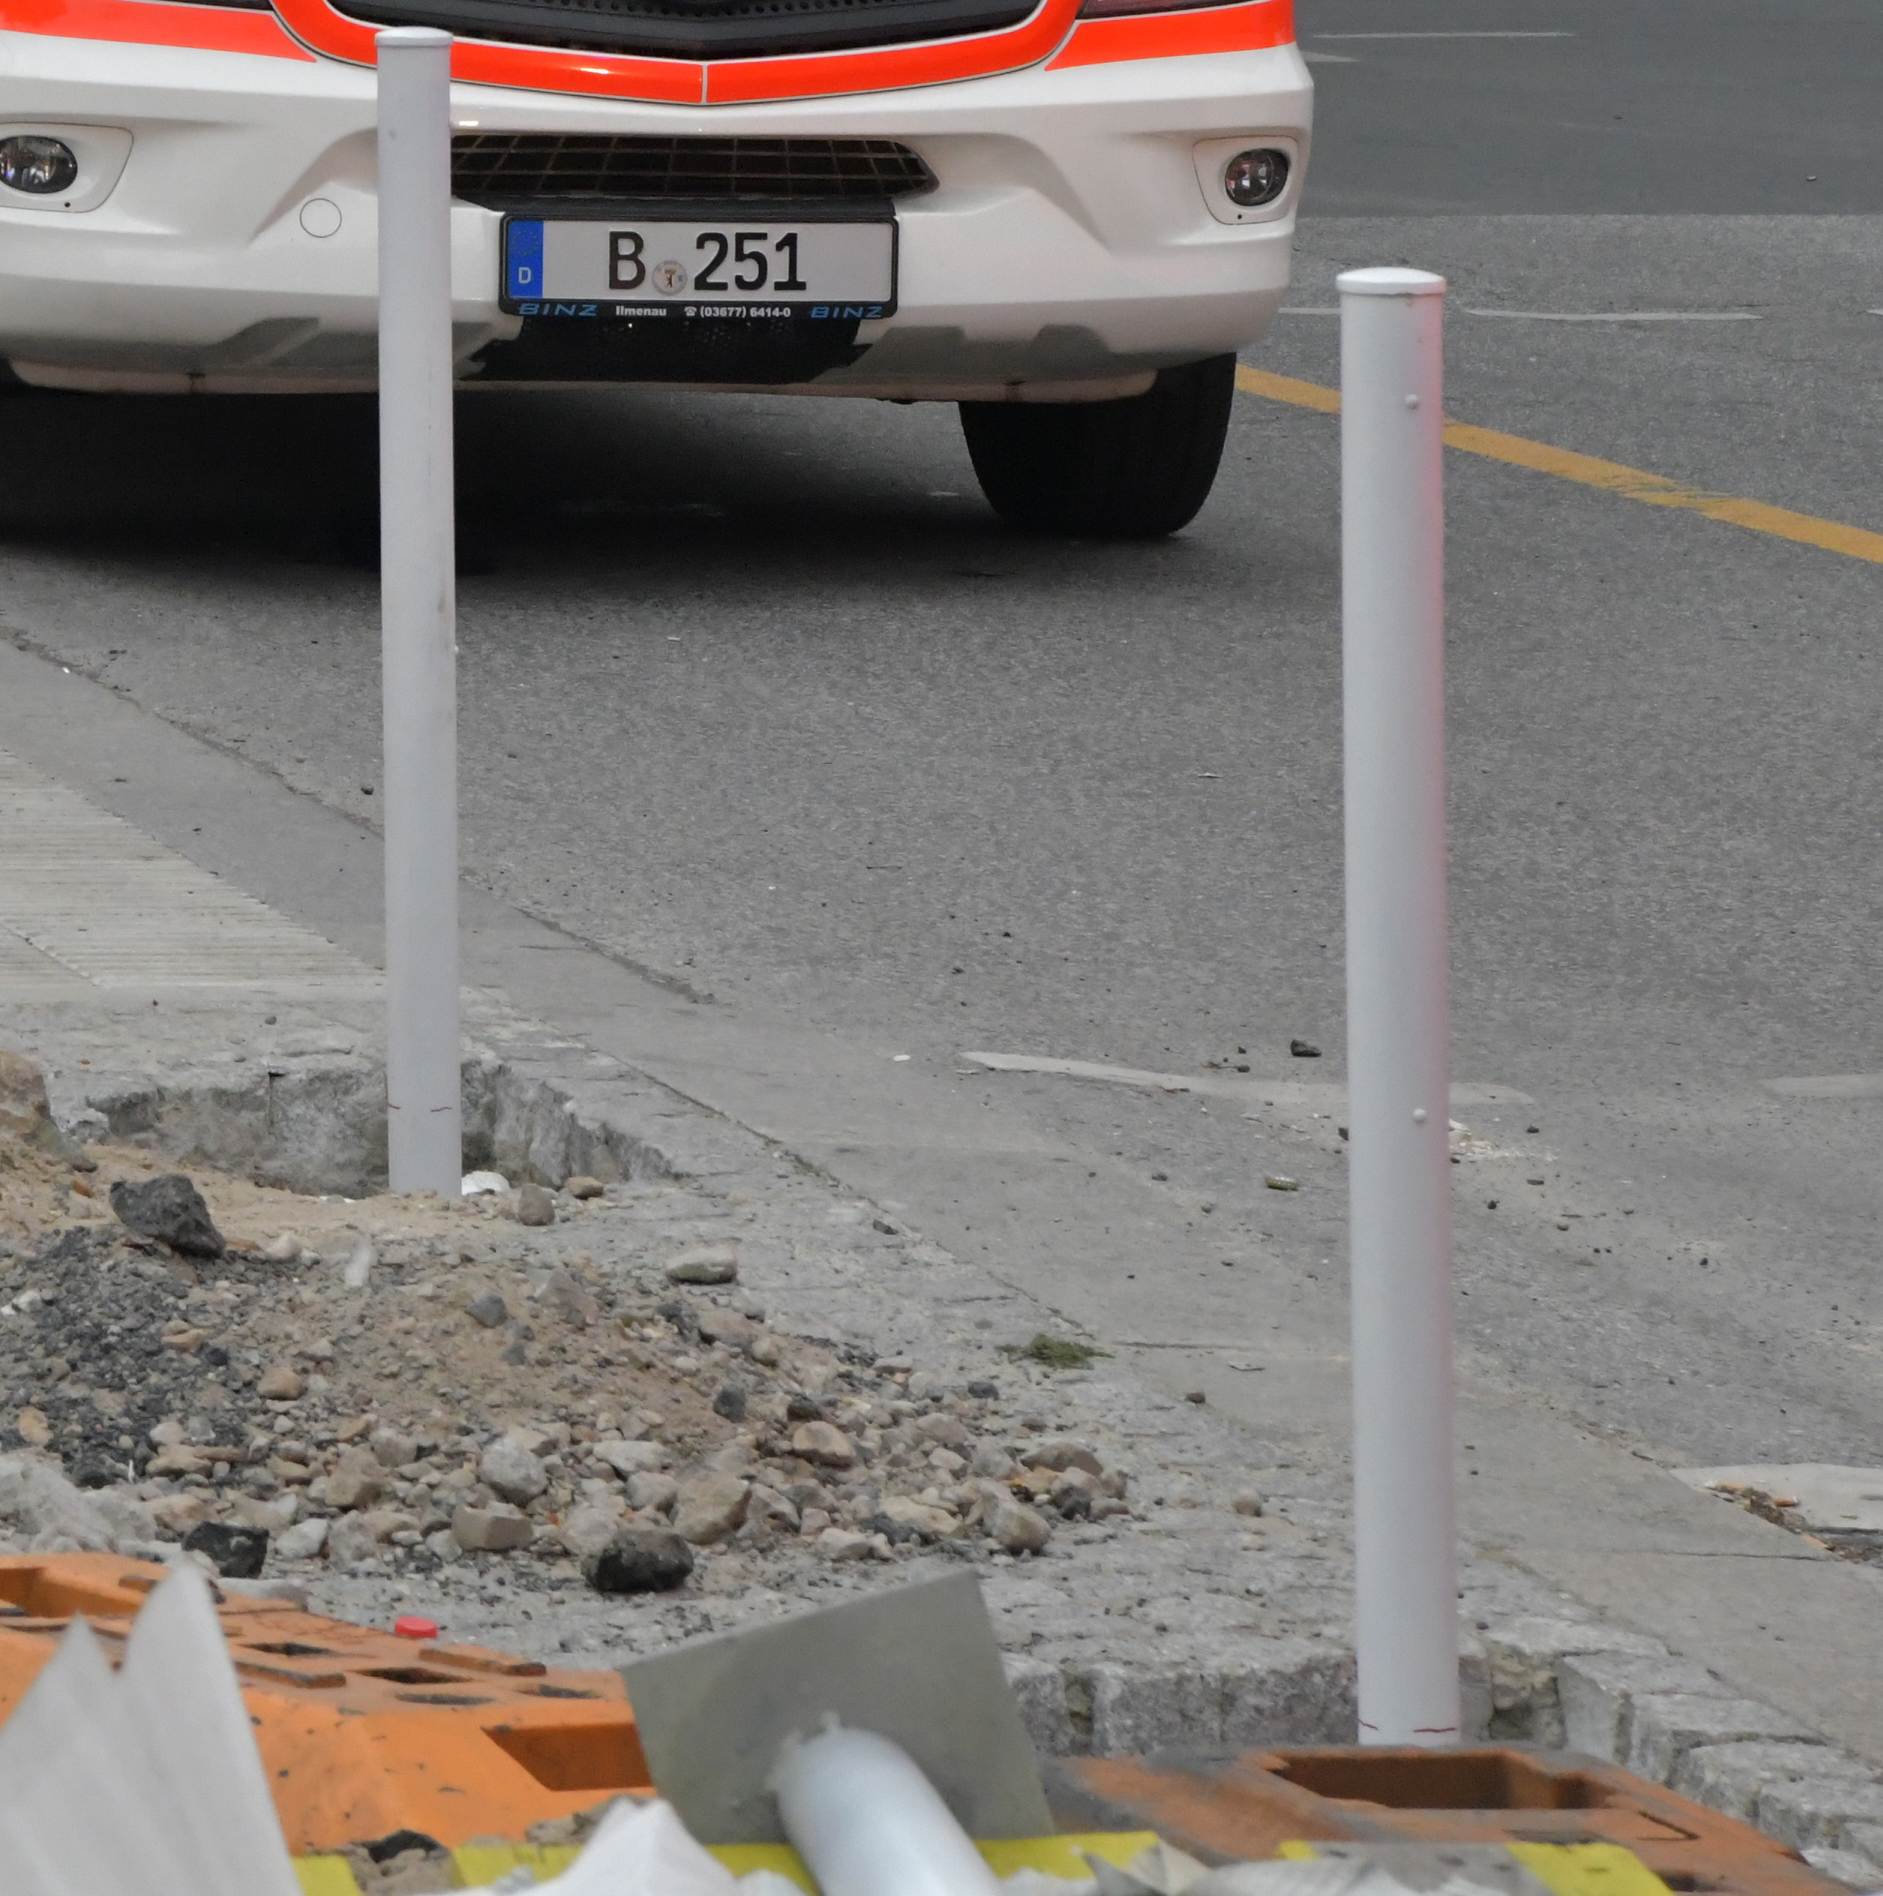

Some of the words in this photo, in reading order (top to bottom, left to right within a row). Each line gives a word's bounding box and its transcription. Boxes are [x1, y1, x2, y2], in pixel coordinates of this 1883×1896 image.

[608, 230, 645, 291] B
[693, 232, 807, 291] 251
[517, 267, 532, 284] D
[518, 303, 598, 317] BINZ
[616, 305, 667, 317] Ilmenau
[700, 305, 747, 319] (03677)
[749, 306, 791, 318] 6414-0
[810, 305, 883, 319] BINZ
